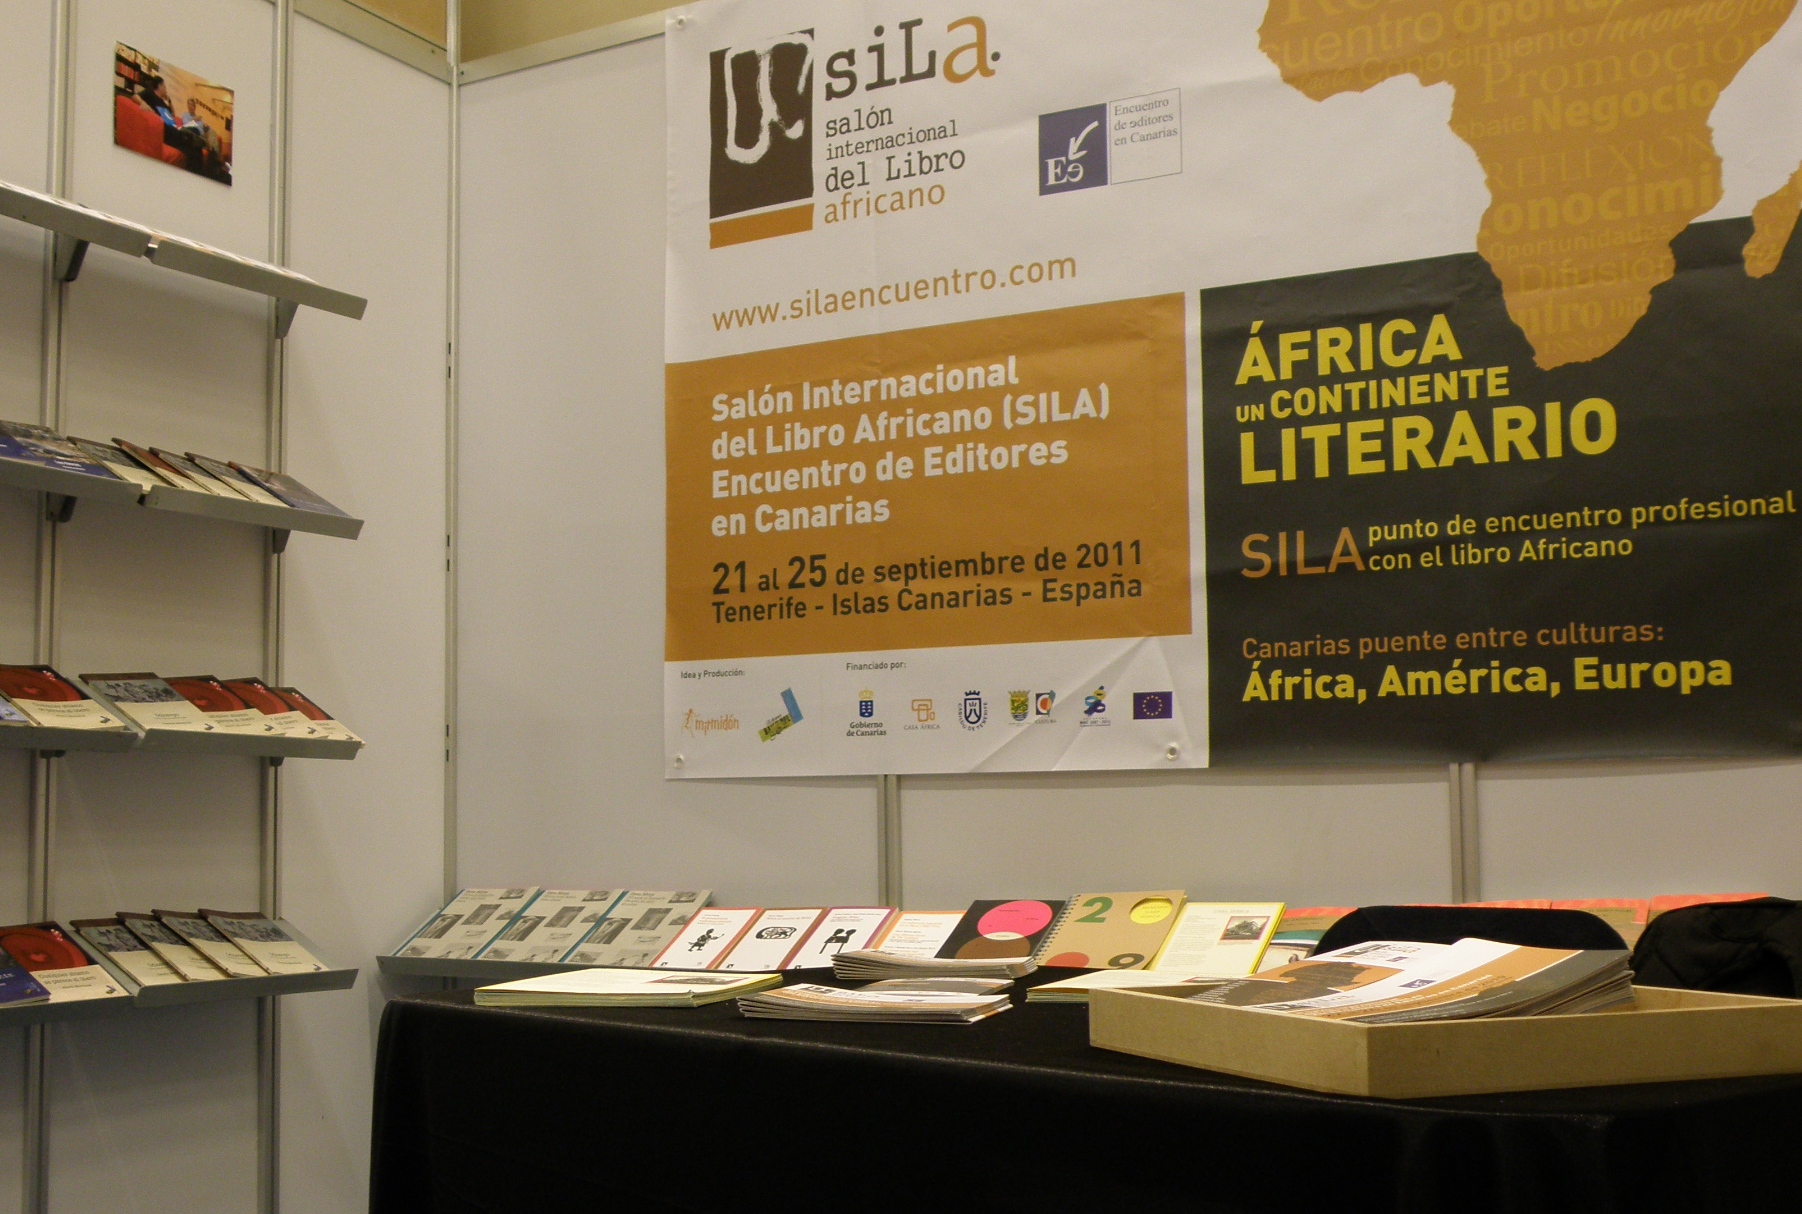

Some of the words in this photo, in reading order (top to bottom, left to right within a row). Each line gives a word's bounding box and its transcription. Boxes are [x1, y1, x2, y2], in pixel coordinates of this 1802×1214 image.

[825, 105, 893, 138] salón
[1114, 98, 1169, 116] Encuentro
[1114, 120, 1127, 131] de
[1532, 73, 1720, 132] Negocio
[827, 119, 959, 161] internacional
[1114, 137, 1127, 146] en
[1130, 127, 1178, 144] Canarias
[825, 160, 870, 193] del
[885, 147, 966, 183] Libro
[824, 183, 946, 225] africano
[712, 255, 1077, 332] www.silaencuentro.com
[1235, 312, 1463, 386] ÁFRICA
[712, 384, 793, 422] Salón
[802, 355, 1019, 412] Internacional
[1236, 402, 1265, 423] UN
[1270, 365, 1510, 419] CONTINENTE
[711, 425, 757, 460] del
[767, 416, 845, 453] Libro
[853, 402, 992, 445] Africano
[1002, 382, 1110, 431] (SILA)
[1239, 396, 1618, 485] LITERARIO
[711, 455, 866, 499] Encuentro
[876, 452, 914, 483] de
[924, 438, 1069, 477] Editores
[711, 509, 745, 537] en
[755, 496, 891, 533] Canarias
[1368, 517, 1439, 548] punto
[1446, 513, 1477, 537] de
[1485, 504, 1622, 535] encuentro
[1631, 489, 1797, 530] profesional
[712, 561, 748, 595] 21
[757, 566, 779, 592] al
[787, 554, 828, 590] 25
[835, 560, 865, 586] de
[872, 547, 1025, 588] septiembre
[1034, 545, 1067, 572] de
[1076, 539, 1143, 569] 2011
[1240, 526, 1366, 579] SILA
[1368, 550, 1412, 572] con
[1419, 543, 1444, 569] el
[1451, 537, 1511, 567] libro
[1518, 534, 1634, 562] Africano
[712, 595, 807, 625] Tenerife
[832, 591, 890, 616] Islas
[897, 580, 1013, 613] Canarias
[1041, 573, 1143, 607] España
[1242, 633, 1352, 660] Canarias
[1358, 629, 1447, 660] puente
[1455, 625, 1528, 652] entre
[1535, 620, 1665, 647] culturas:
[680, 671, 697, 680] Idea
[846, 661, 888, 671] Financiado
[1242, 661, 1367, 705] África,
[1378, 658, 1561, 699] América,
[1574, 656, 1733, 695] Europa
[846, 729, 855, 737] de
[856, 728, 887, 737] Canarias
[849, 720, 883, 730] Gobierno
